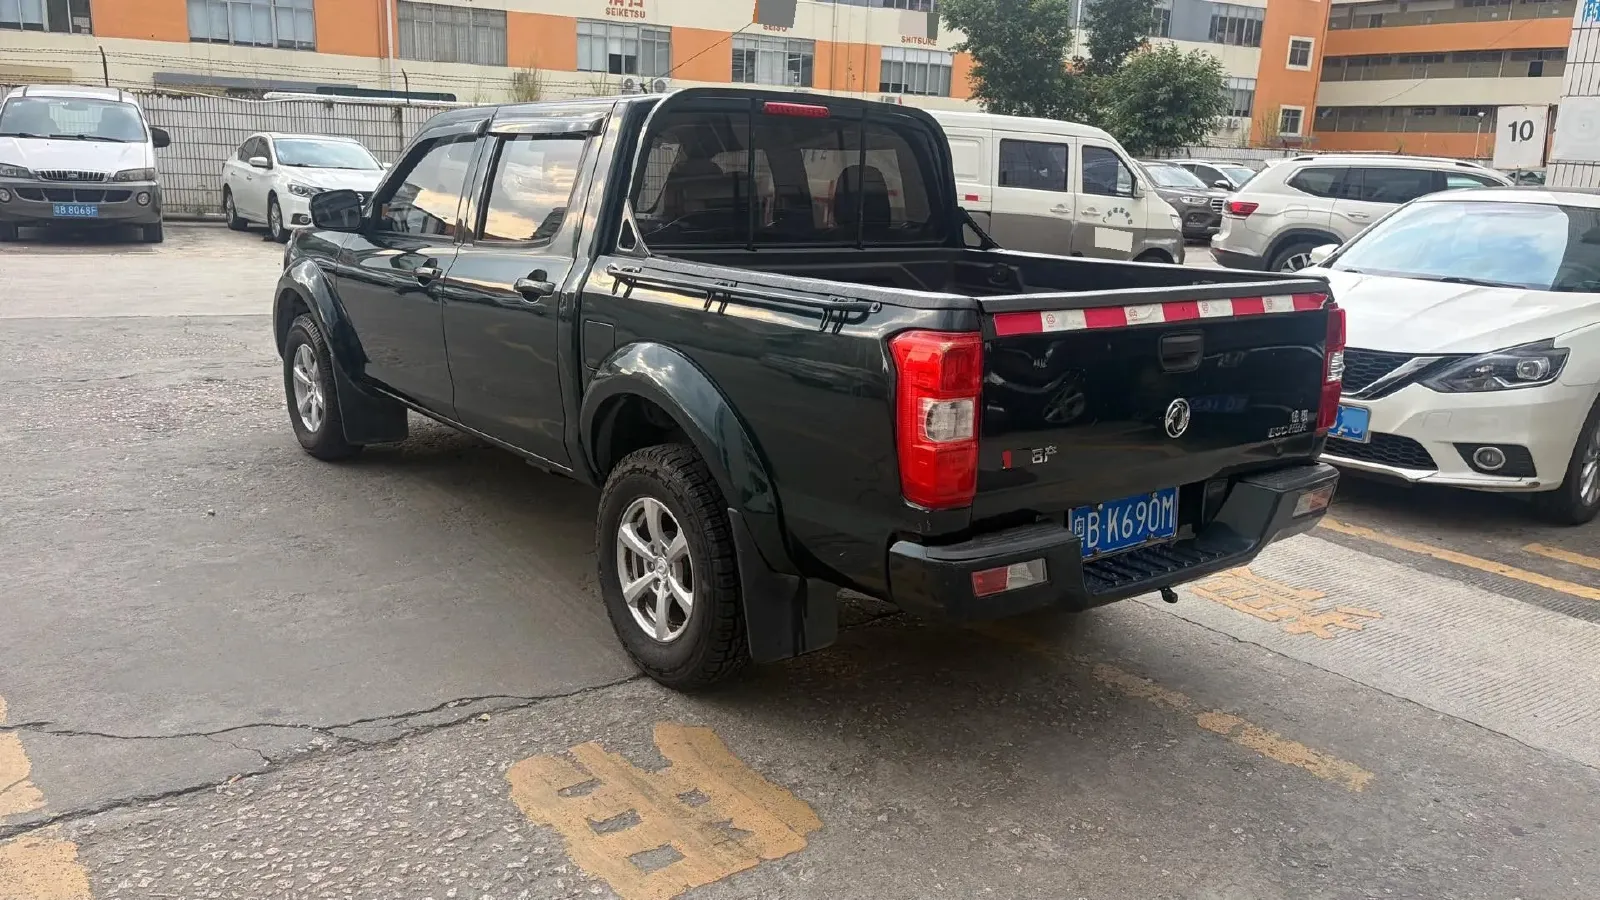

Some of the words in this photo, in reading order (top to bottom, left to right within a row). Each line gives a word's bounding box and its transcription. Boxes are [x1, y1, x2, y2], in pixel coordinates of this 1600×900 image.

[605, 8, 646, 18] SEIKETSU
[901, 36, 937, 46] SHITSUKE
[1508, 119, 1534, 142] 10
